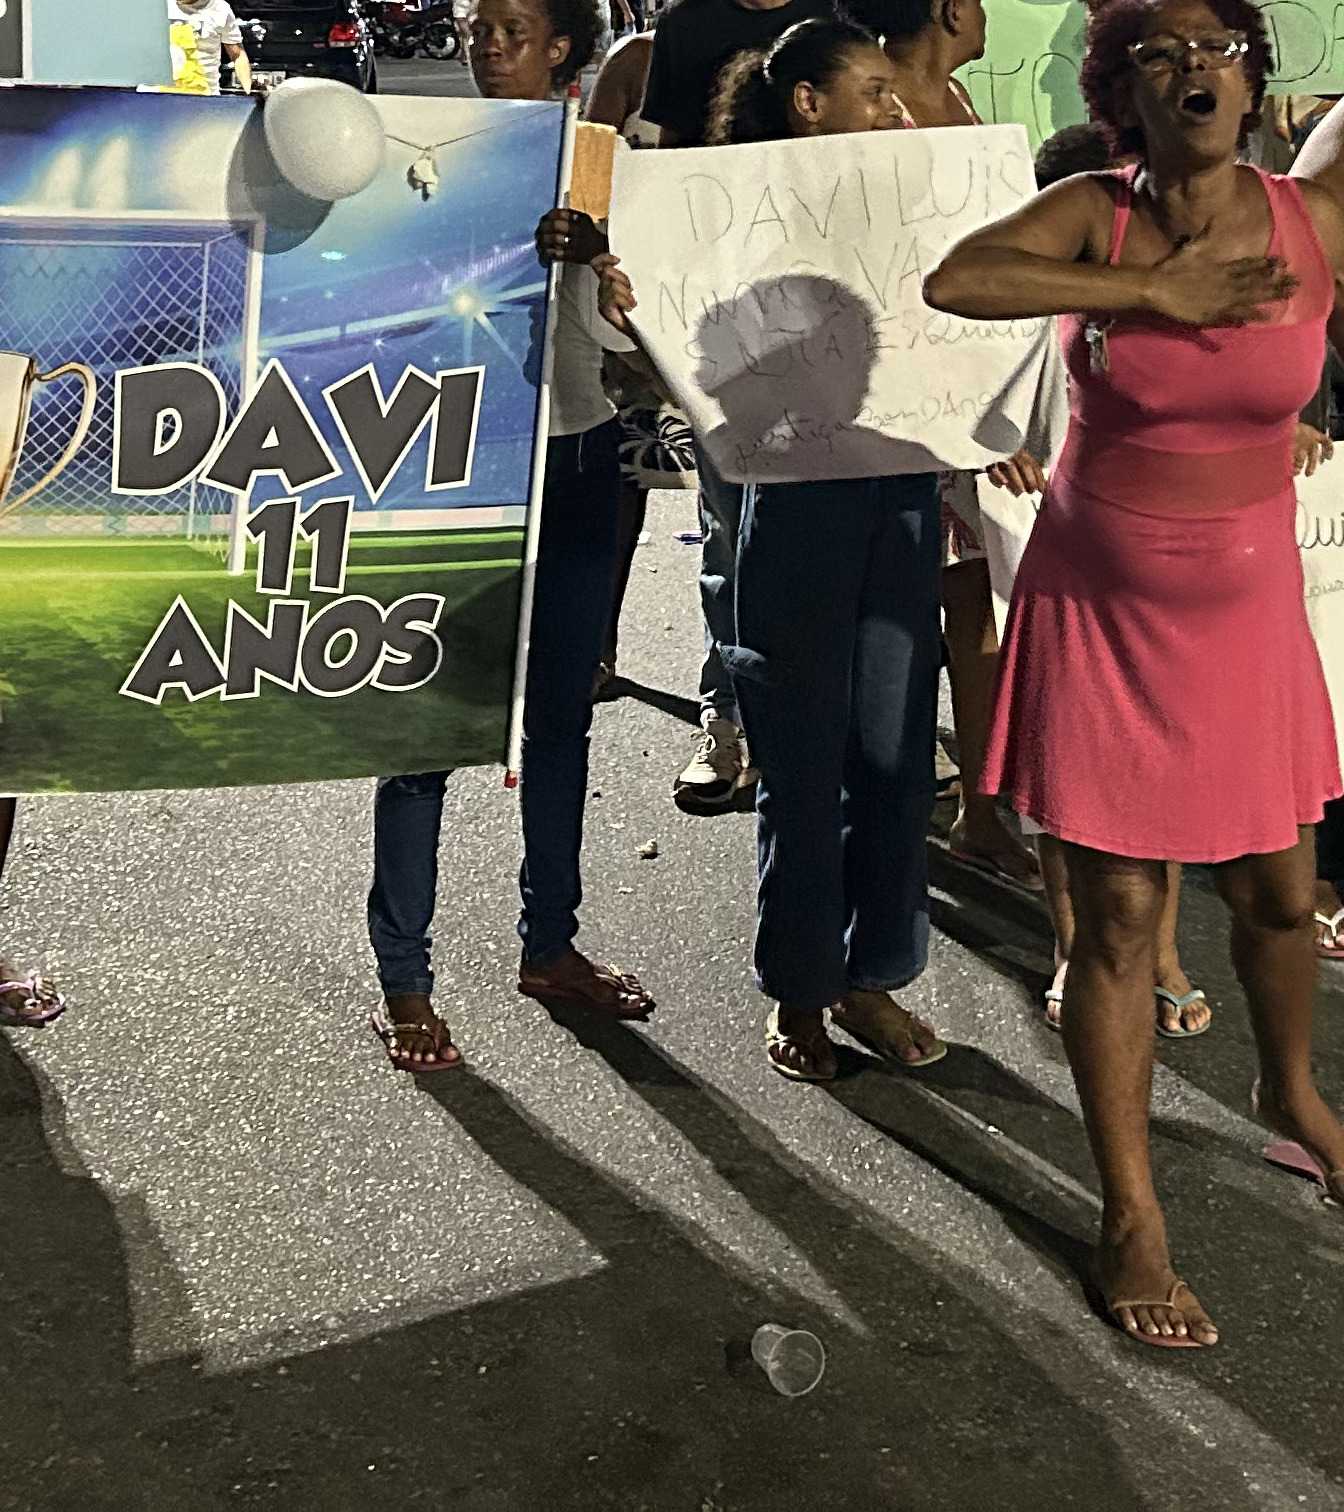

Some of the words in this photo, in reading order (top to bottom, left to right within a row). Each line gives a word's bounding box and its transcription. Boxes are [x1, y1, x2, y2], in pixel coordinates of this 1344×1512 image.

[683, 168, 871, 248] DAVI
[111, 357, 487, 505] DAVI
[246, 494, 355, 596] 11
[118, 592, 446, 706] ANOS
